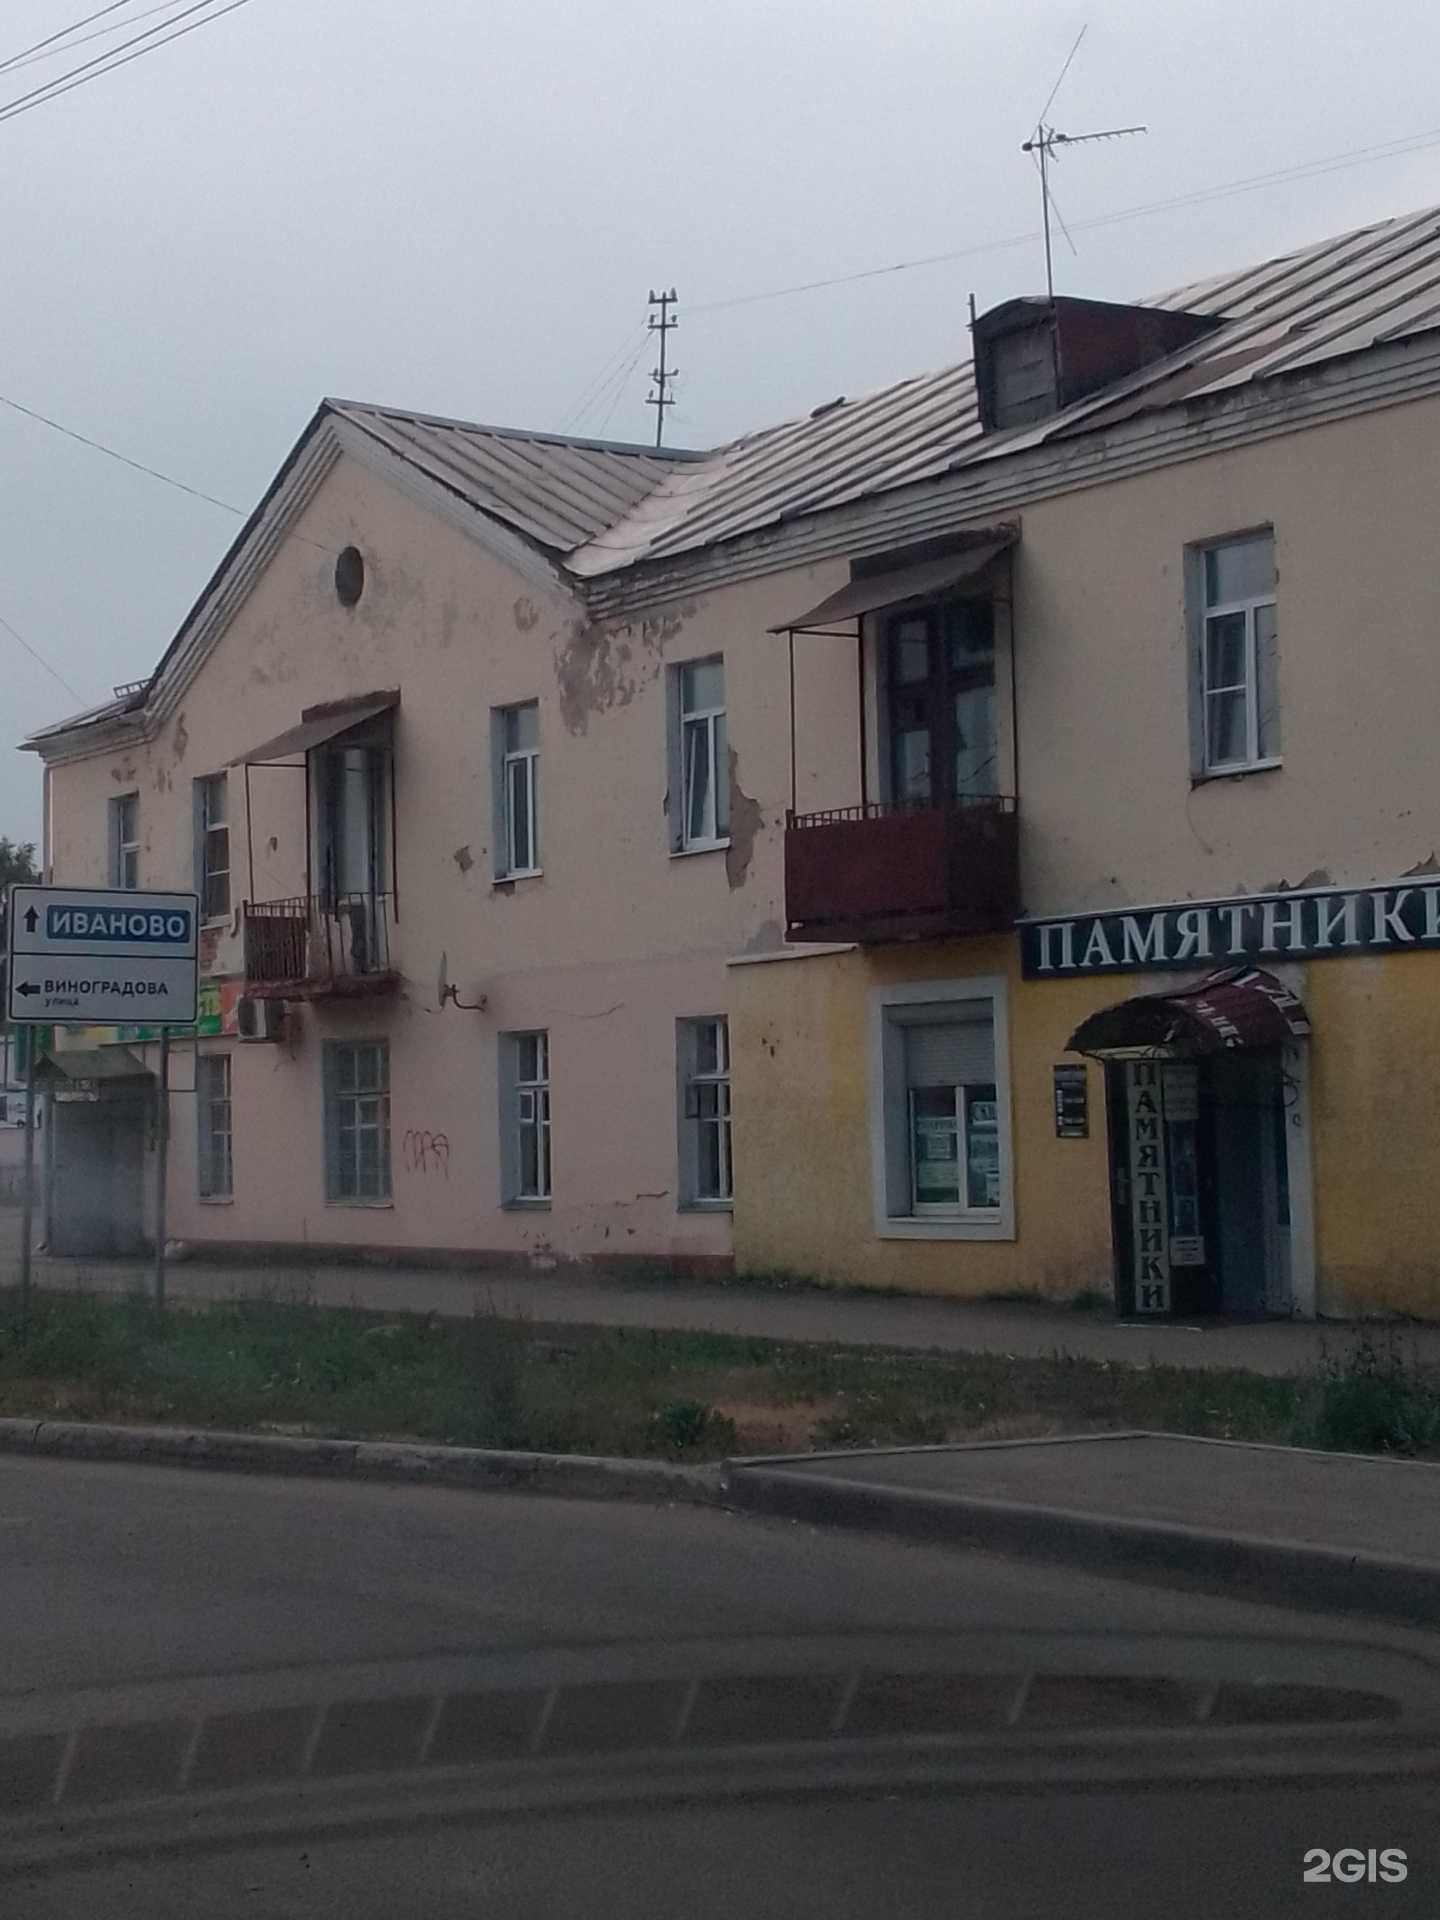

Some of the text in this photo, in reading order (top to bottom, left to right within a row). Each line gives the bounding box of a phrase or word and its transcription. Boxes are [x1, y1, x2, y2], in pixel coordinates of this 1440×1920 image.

[52, 912, 185, 937] ИВАНОВО
[45, 980, 168, 996] ВИНОГРАДОВА
[45, 998, 79, 1006] улица
[1133, 1062, 1164, 1309] ПАМЯТНИКИ
